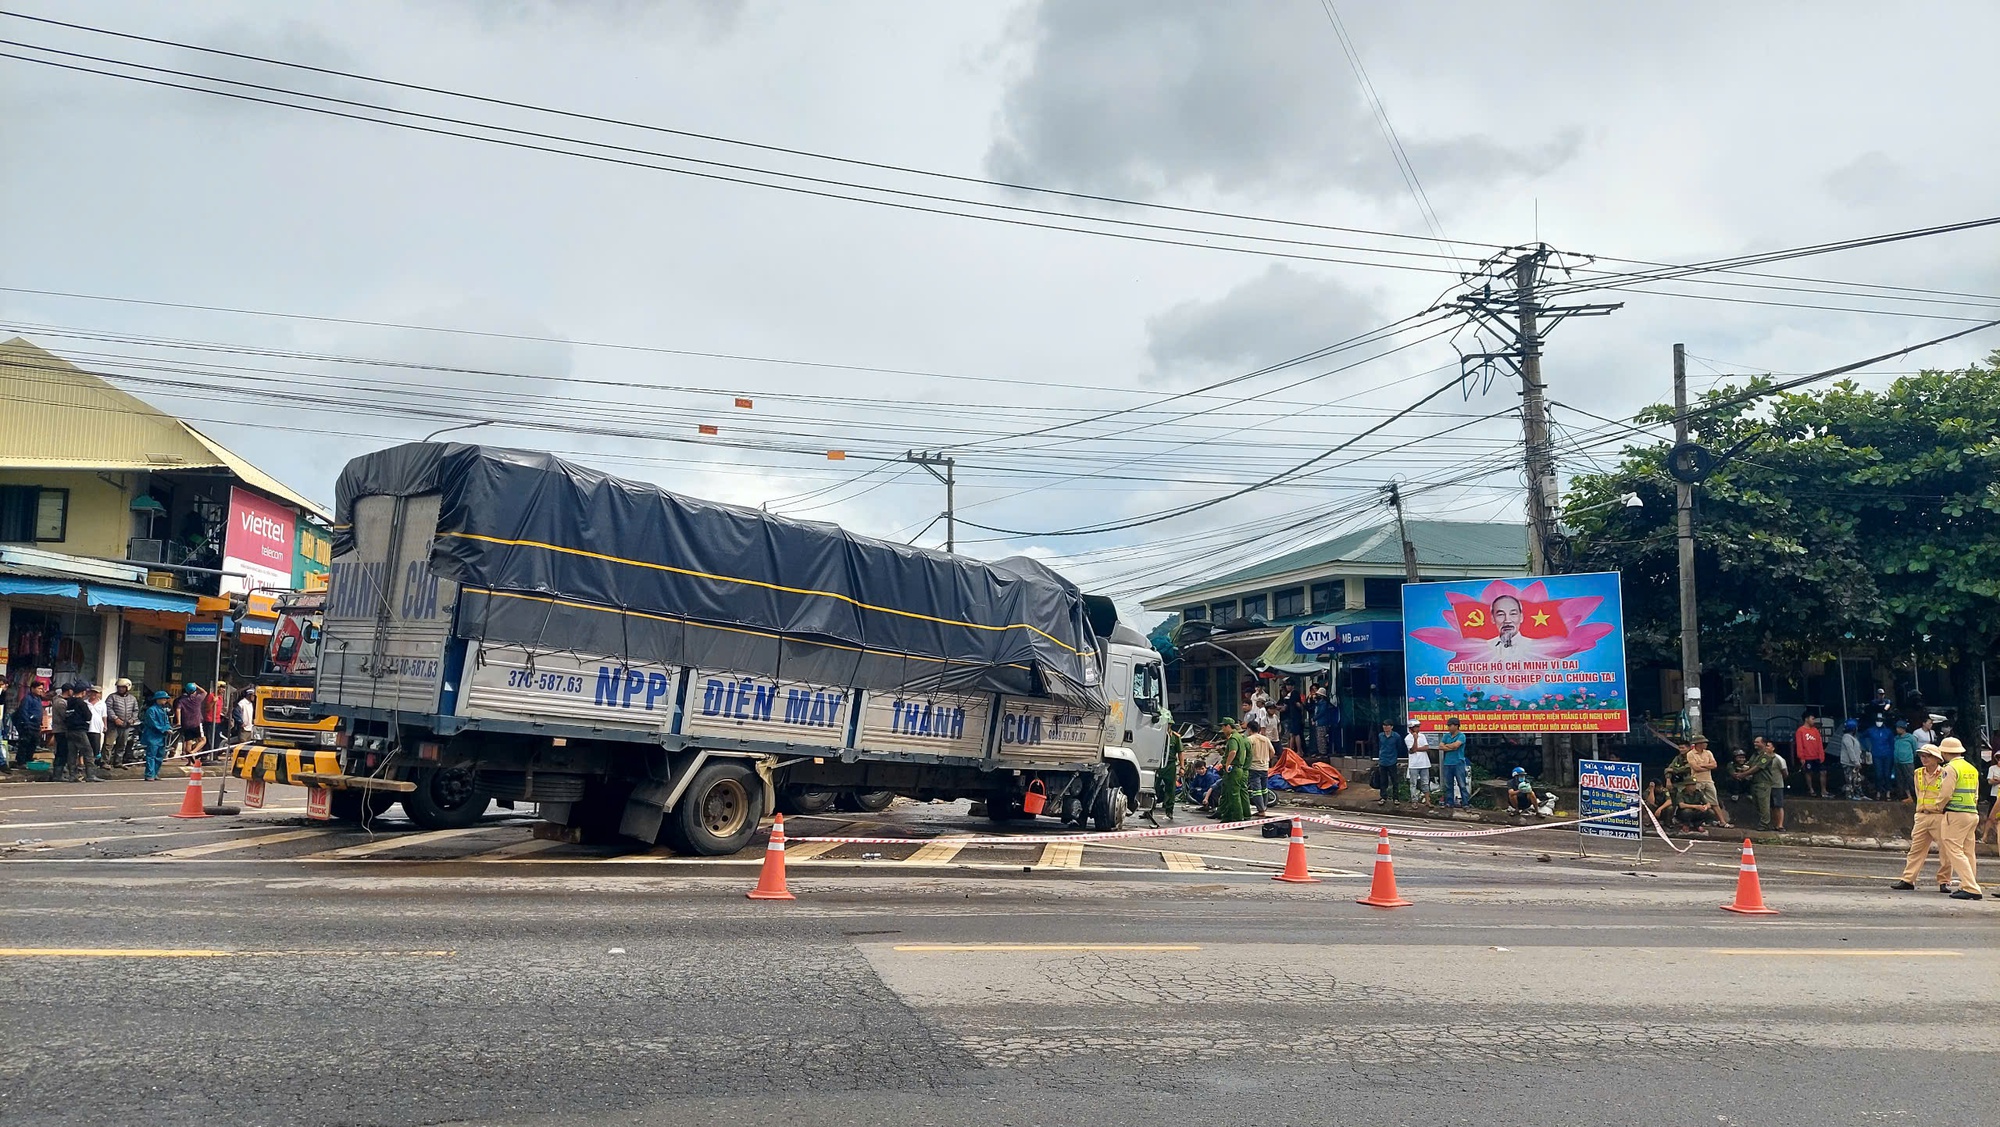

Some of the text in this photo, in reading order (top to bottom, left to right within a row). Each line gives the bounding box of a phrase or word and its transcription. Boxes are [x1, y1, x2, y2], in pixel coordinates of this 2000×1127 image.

[242, 511, 284, 543] viettel
[261, 545, 284, 560] telecom
[1305, 631, 1330, 641] ATM
[1342, 633, 1352, 644] MB
[1448, 661, 1466, 671] CHỦ
[1506, 660, 1520, 670] CHÍ
[1524, 661, 1548, 670] MINH
[1562, 660, 1578, 670] ĐẠI
[1416, 674, 1440, 685] SỐNG
[1462, 675, 1491, 684] TRONG
[1494, 674, 1506, 685] SỰ
[1508, 673, 1541, 684] NGHIỆP
[1544, 672, 1563, 682] CỦA
[1566, 672, 1598, 682] CHÚNG
[1601, 672, 1616, 682] TA!
[508, 670, 584, 693] 37C-587.63
[594, 666, 667, 710] NPP
[702, 677, 776, 725] ĐIỆN
[1582, 772, 1638, 790] CHÌA KHOÁ
[246, 795, 260, 804] TRUCK
[309, 806, 326, 815] TRUCK
